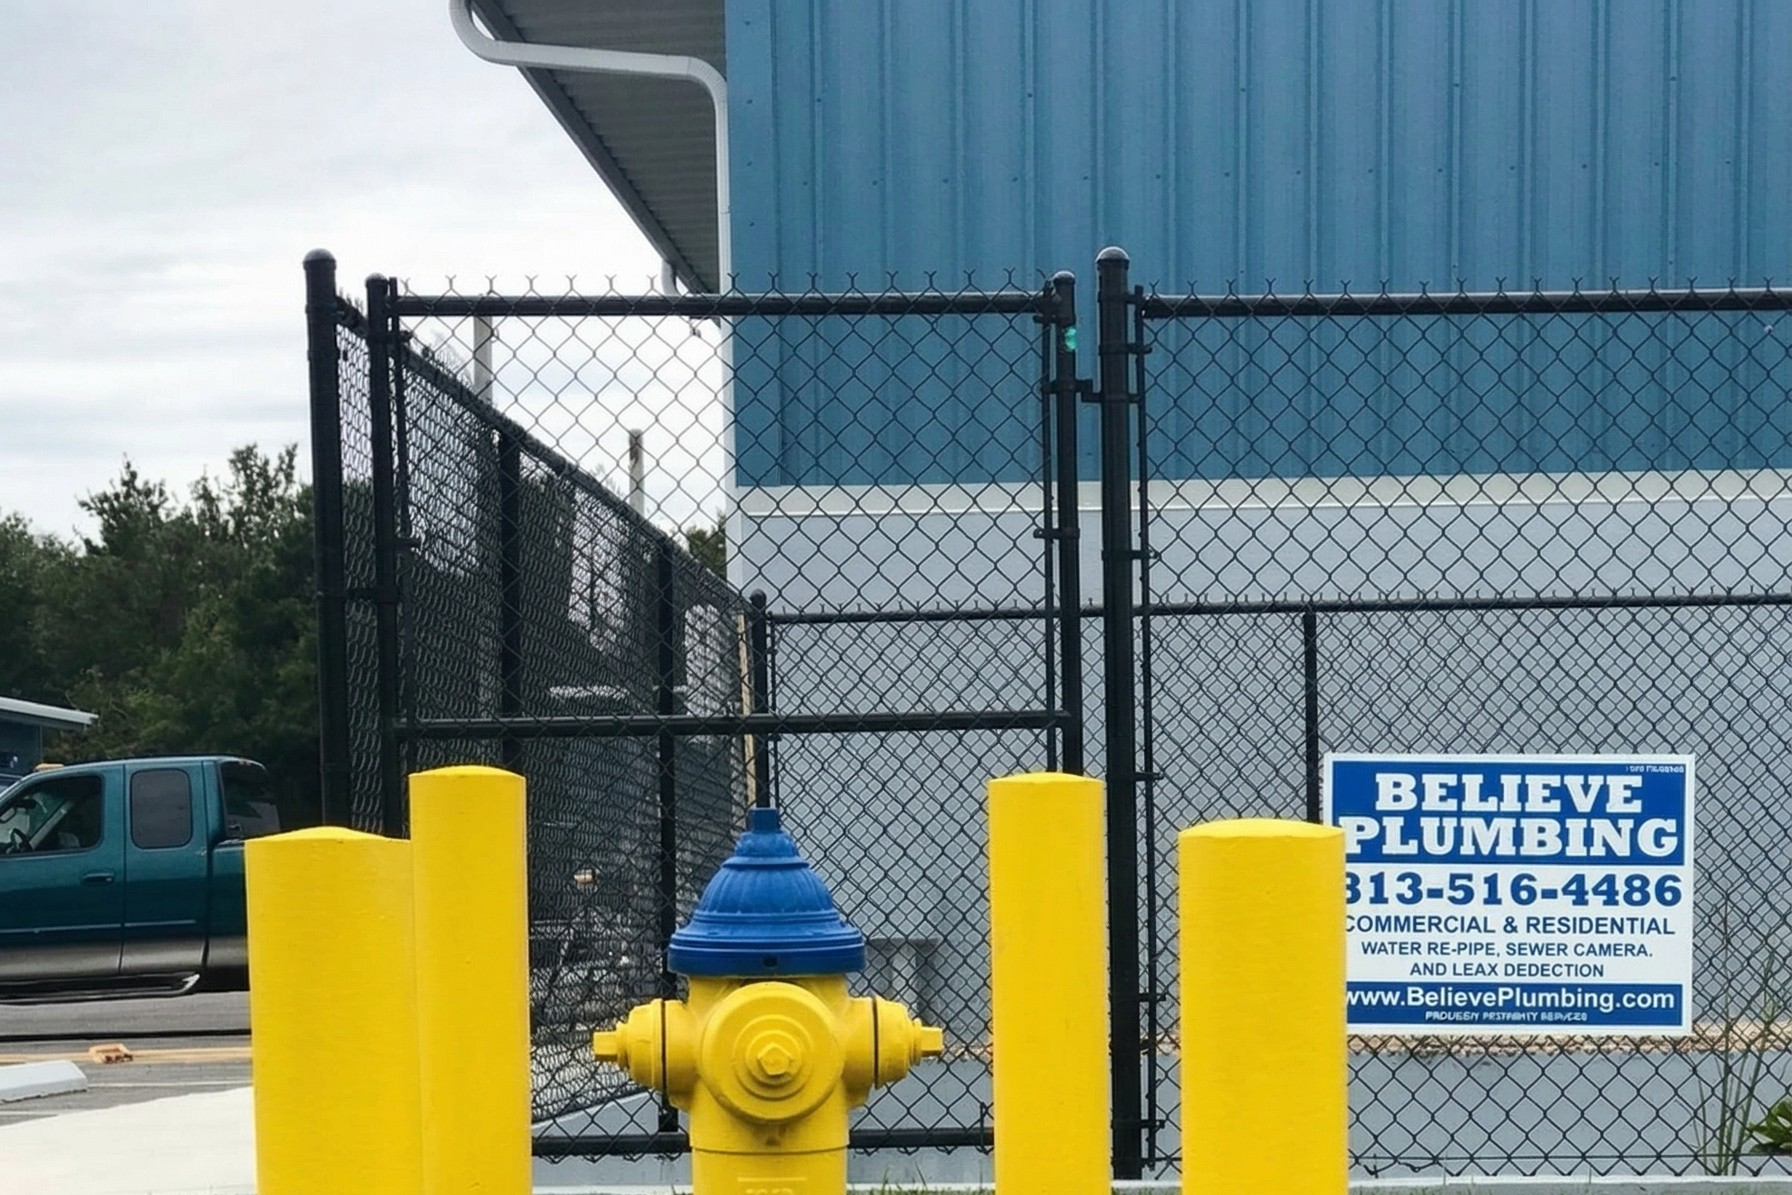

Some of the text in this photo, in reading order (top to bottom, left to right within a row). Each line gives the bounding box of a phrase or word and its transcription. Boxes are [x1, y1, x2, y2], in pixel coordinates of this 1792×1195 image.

[1375, 773, 1642, 813] BELIEVE
[1338, 816, 1678, 857] PLUMBING
[1346, 915, 1675, 935] COMMERCIAL & RESIDENTIAL
[1361, 941, 1422, 955] WATER
[1427, 942, 1500, 957] RE-PIPE,
[1506, 942, 1568, 956] SEWER
[1410, 963, 1447, 976] AND
[1504, 963, 1604, 977] DEDECTION
[1346, 986, 1675, 1013] www.BelievePlumbing.com
